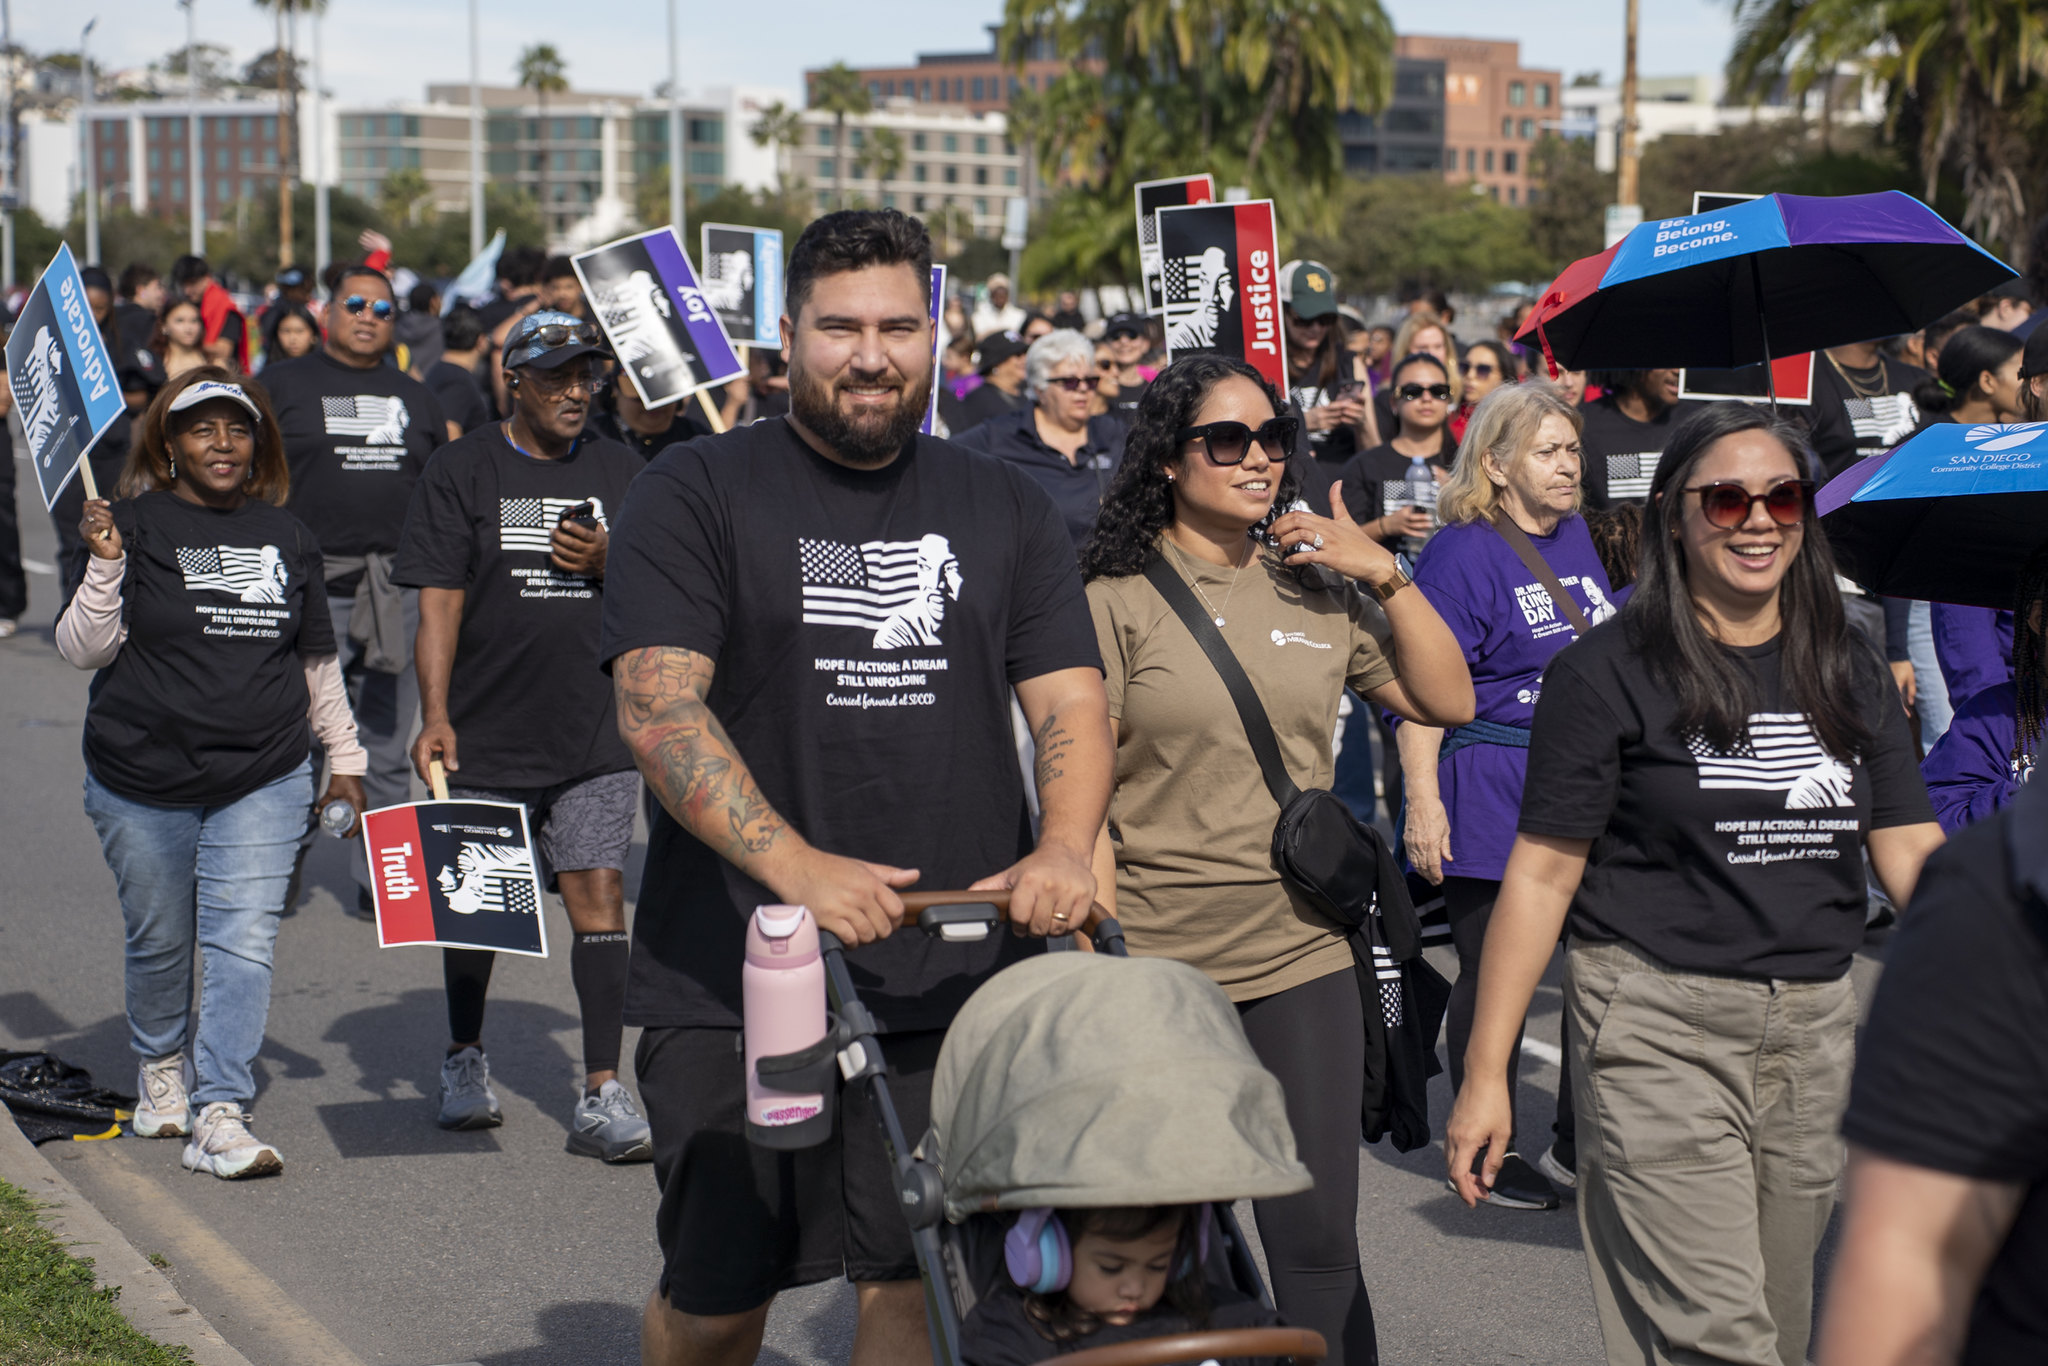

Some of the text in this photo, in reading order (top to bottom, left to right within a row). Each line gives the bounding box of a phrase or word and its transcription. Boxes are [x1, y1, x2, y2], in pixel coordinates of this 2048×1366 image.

[1655, 220, 1731, 243] Belong.
[1659, 219, 1690, 230] Be.
[1653, 231, 1738, 258] Become.
[677, 285, 712, 323] Joy
[1246, 250, 1276, 355] Justice
[60, 274, 110, 402] Advocate
[1949, 453, 2031, 465] SAN DIEGO
[1931, 464, 1977, 474] Community
[1980, 463, 2010, 472] College
[1514, 585, 1528, 597] DR.
[1559, 575, 1580, 587] THER
[1517, 590, 1553, 611] KING
[195, 605, 217, 614] HOPE
[228, 607, 258, 616] ACTION:
[259, 609, 266, 617] A
[266, 609, 290, 619] DREAM
[212, 614, 278, 627] STILL UNFOLDING
[1523, 604, 1556, 626] DAY
[814, 658, 948, 673] HOPE IN ACTION: A DREAM
[837, 674, 926, 688] STILL UNFOLDING
[826, 692, 935, 709] Carried forward at SDCCD
[1714, 819, 1859, 832] HOPE IN ACTION: A DREAM
[1737, 833, 1834, 845] STILL UNFOLDING
[1727, 849, 1761, 865] Carried
[1761, 848, 1795, 865] forward
[380, 841, 420, 901] Truth
